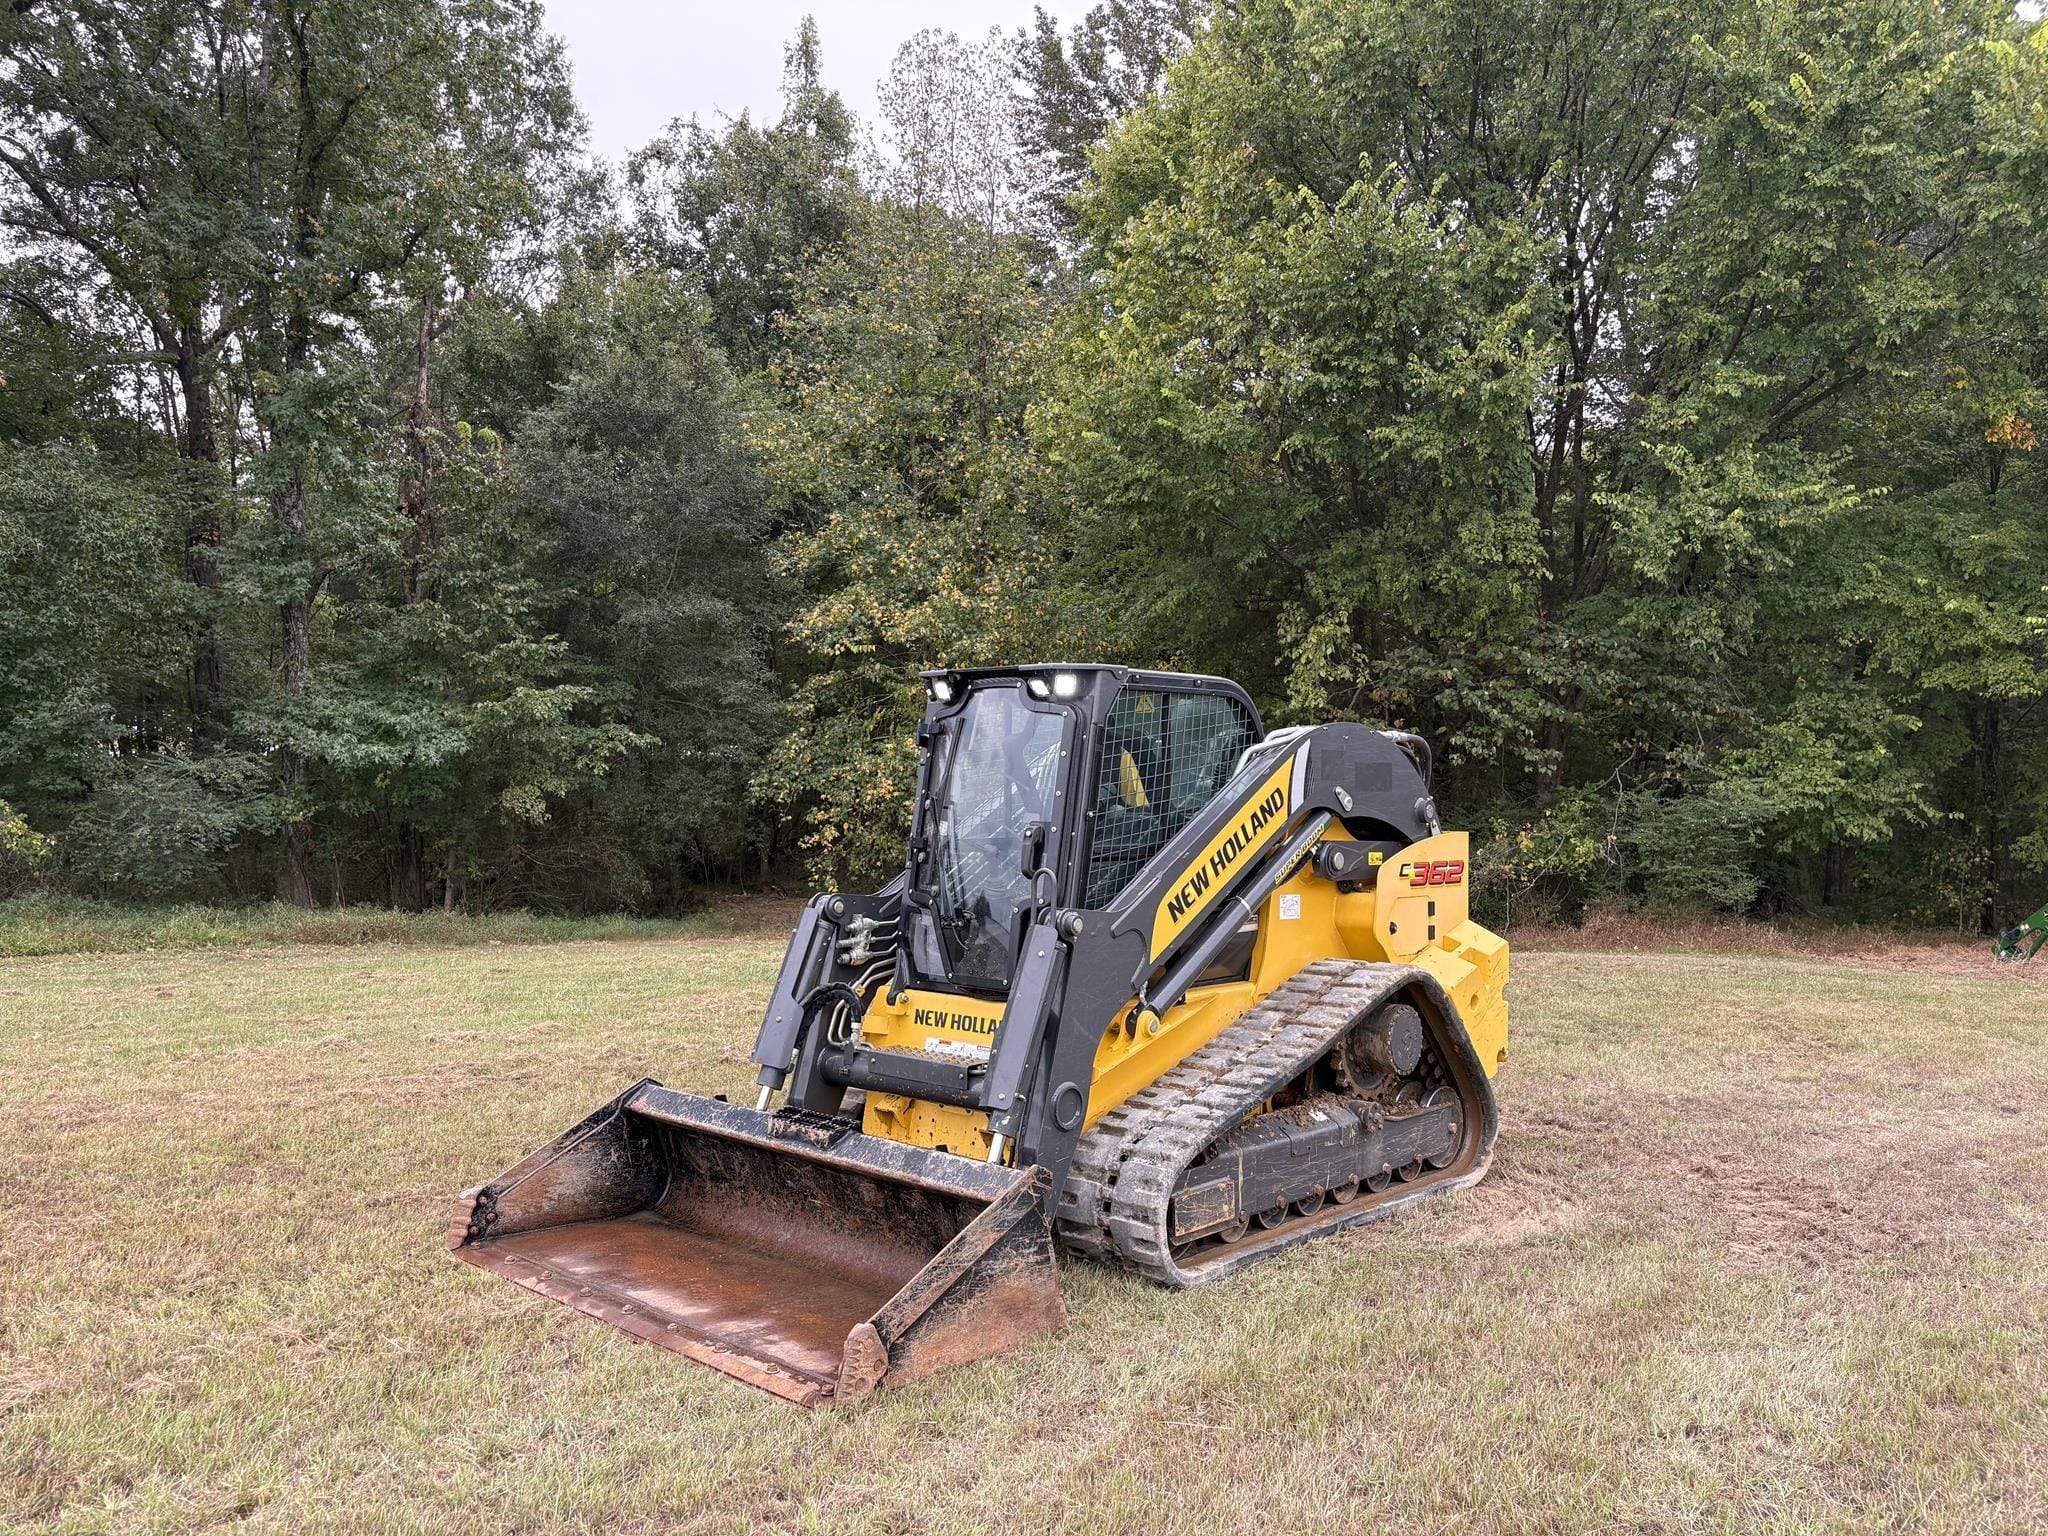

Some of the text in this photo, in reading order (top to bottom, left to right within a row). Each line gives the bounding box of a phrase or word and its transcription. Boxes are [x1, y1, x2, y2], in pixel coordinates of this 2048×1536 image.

[1167, 787, 1284, 924] NEW HOLLAND
[1275, 849, 1302, 884] SUPER
[1301, 823, 1325, 854] BOOM
[914, 1008, 1002, 1034] NEW HOLLA
